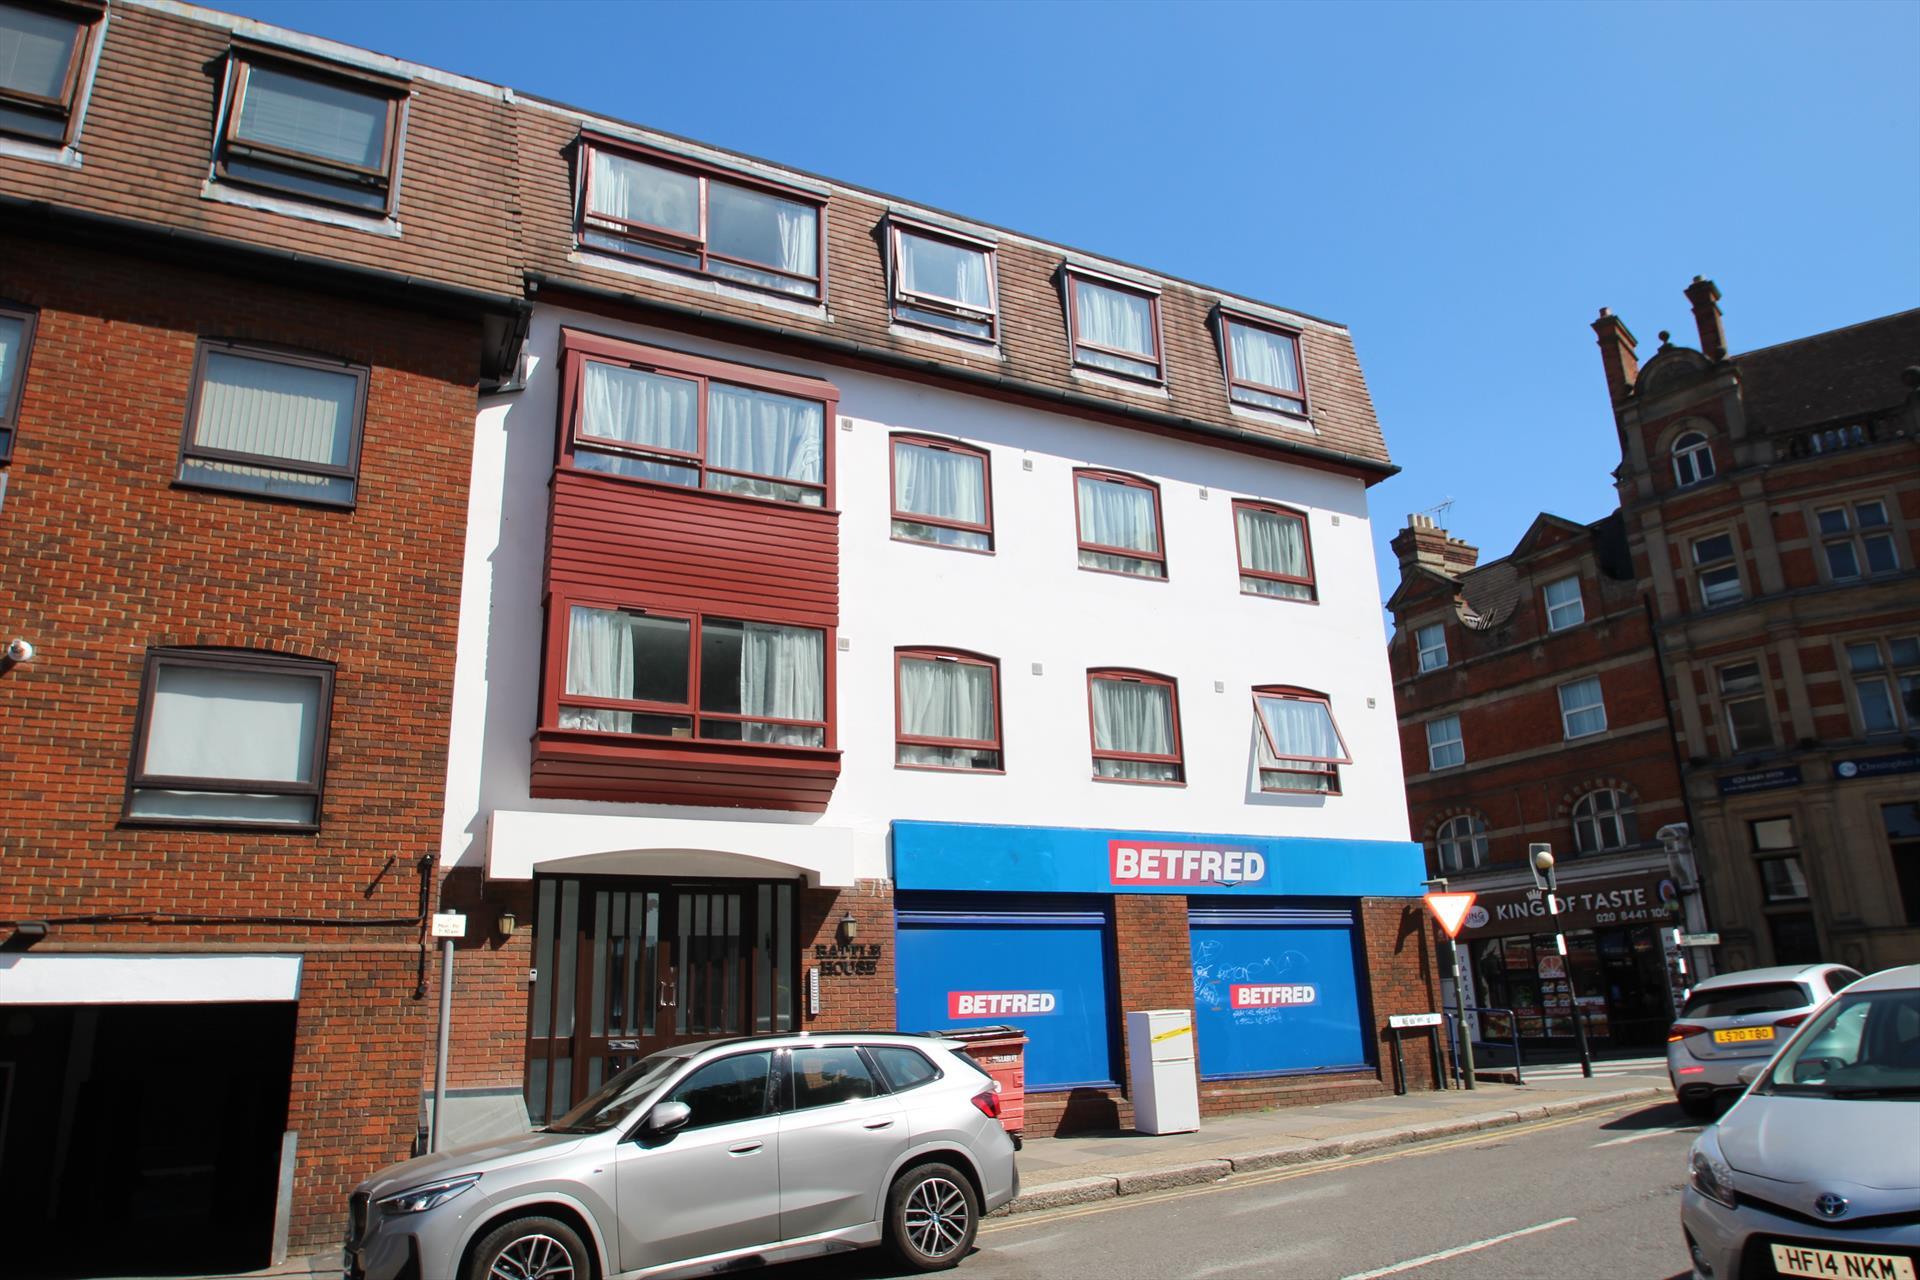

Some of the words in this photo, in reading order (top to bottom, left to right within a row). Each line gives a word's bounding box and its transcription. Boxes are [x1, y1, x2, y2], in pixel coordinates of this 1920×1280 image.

[1116, 847, 1265, 881] BETFRED
[1497, 900, 1546, 921] KING
[1581, 888, 1647, 910] TASTE
[1596, 911, 1617, 923] 020
[820, 960, 877, 976] HOUSE
[958, 993, 1055, 1015] BETFRED
[1238, 986, 1315, 1005] BETFRED
[1719, 1031, 1745, 1042] LS70
[1785, 1248, 1838, 1275] HF14
[1844, 1255, 1898, 1280] NKM
